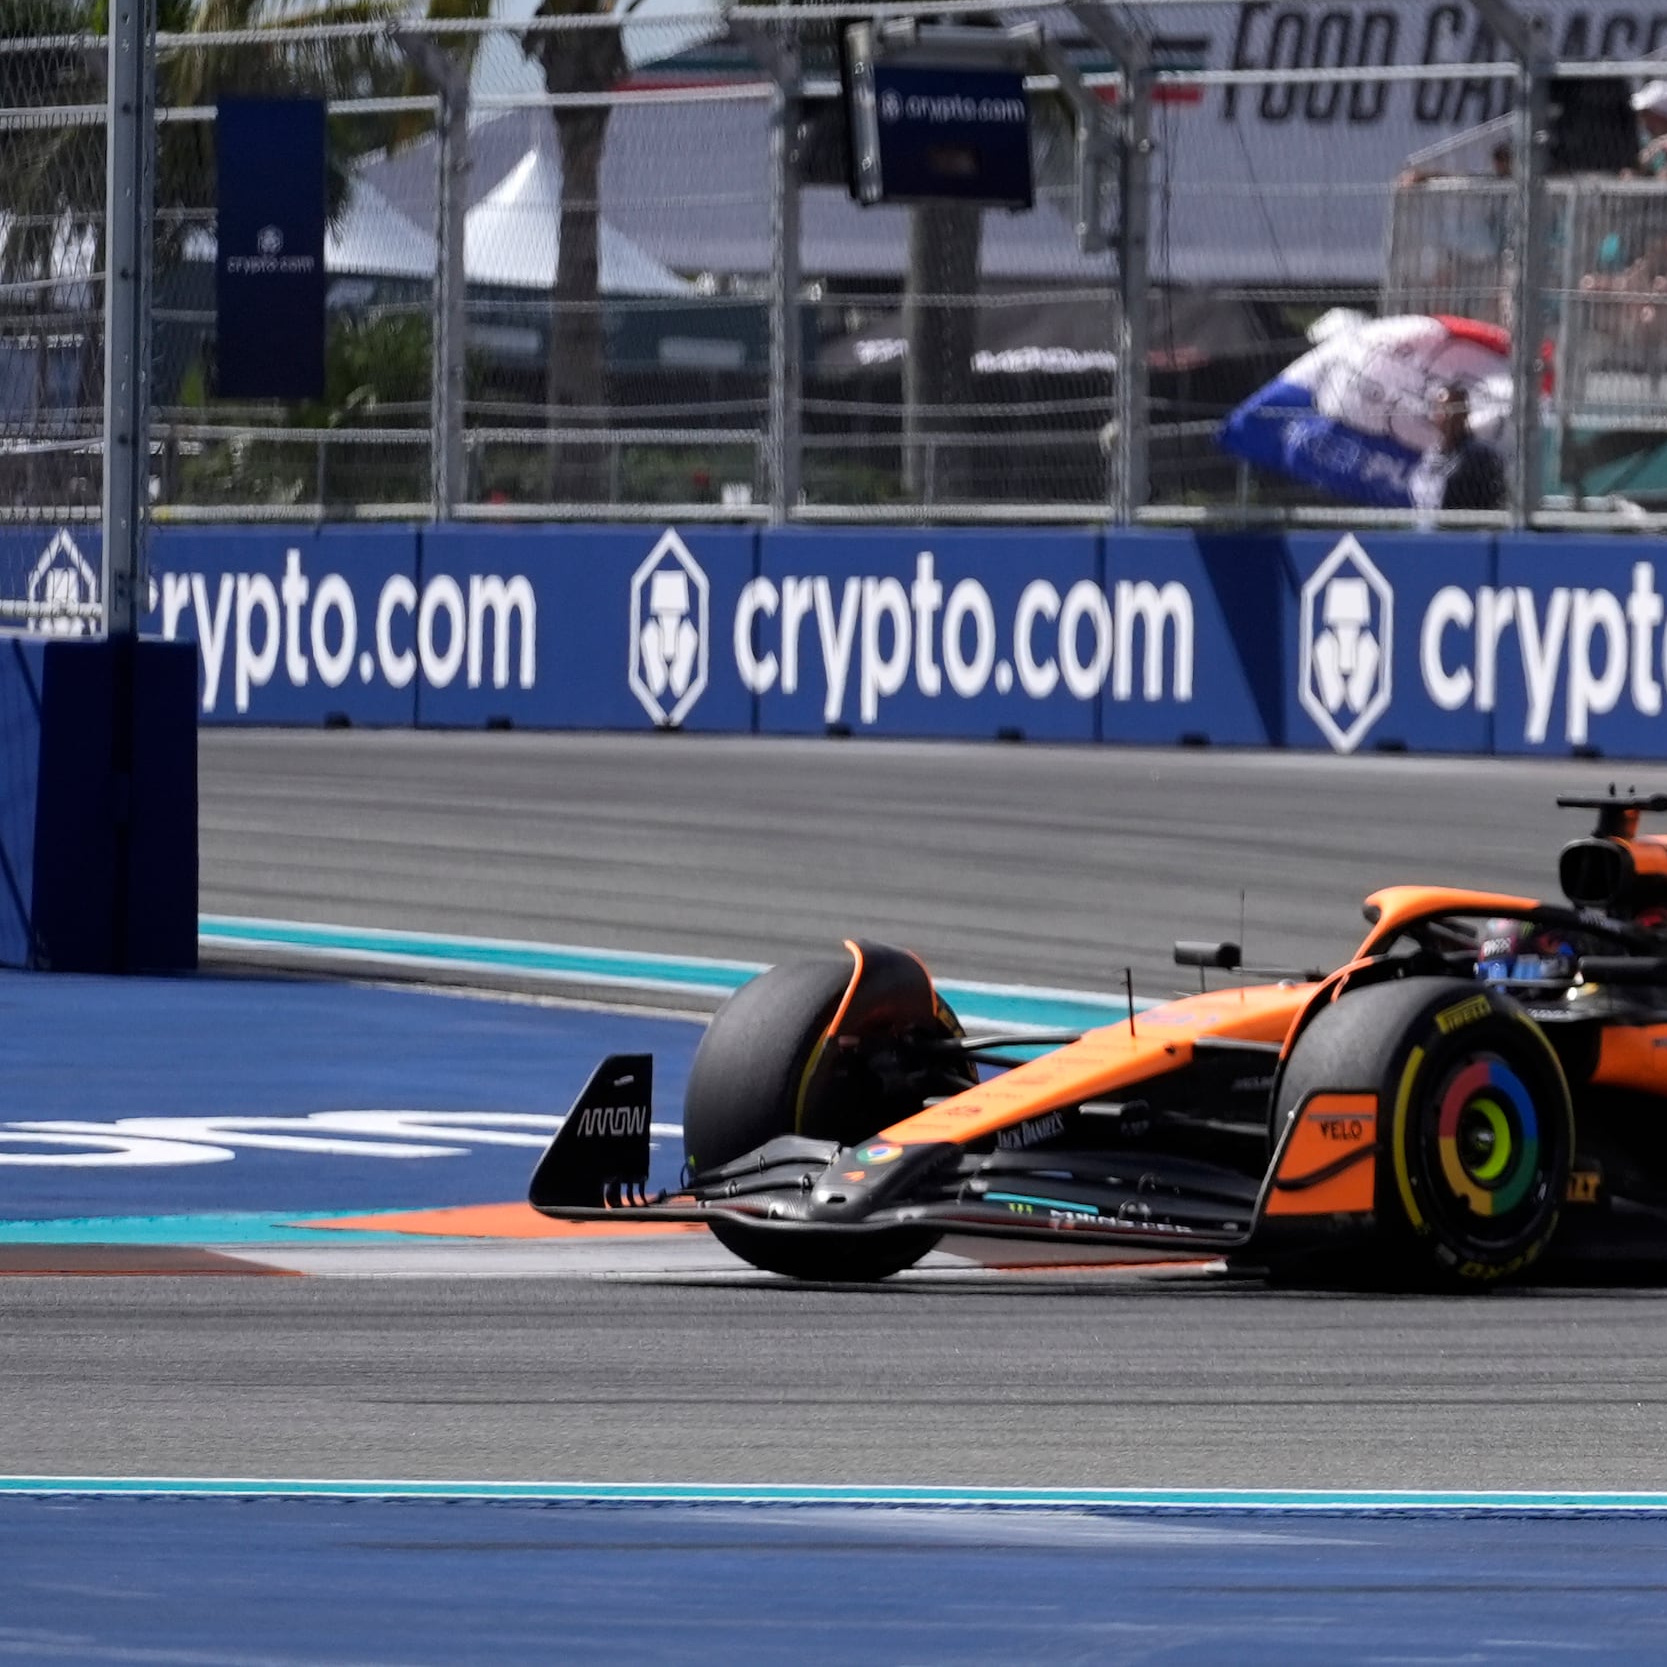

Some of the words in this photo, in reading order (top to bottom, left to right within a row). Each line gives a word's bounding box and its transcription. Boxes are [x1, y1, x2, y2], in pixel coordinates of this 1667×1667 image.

[1222, 1, 1399, 122] FOOD
[905, 94, 1025, 124] crypto.com
[147, 548, 537, 714] rypto.com
[733, 551, 1193, 724] crypto.com
[577, 1105, 647, 1137] ARROW
[1319, 1121, 1363, 1142] VELO
